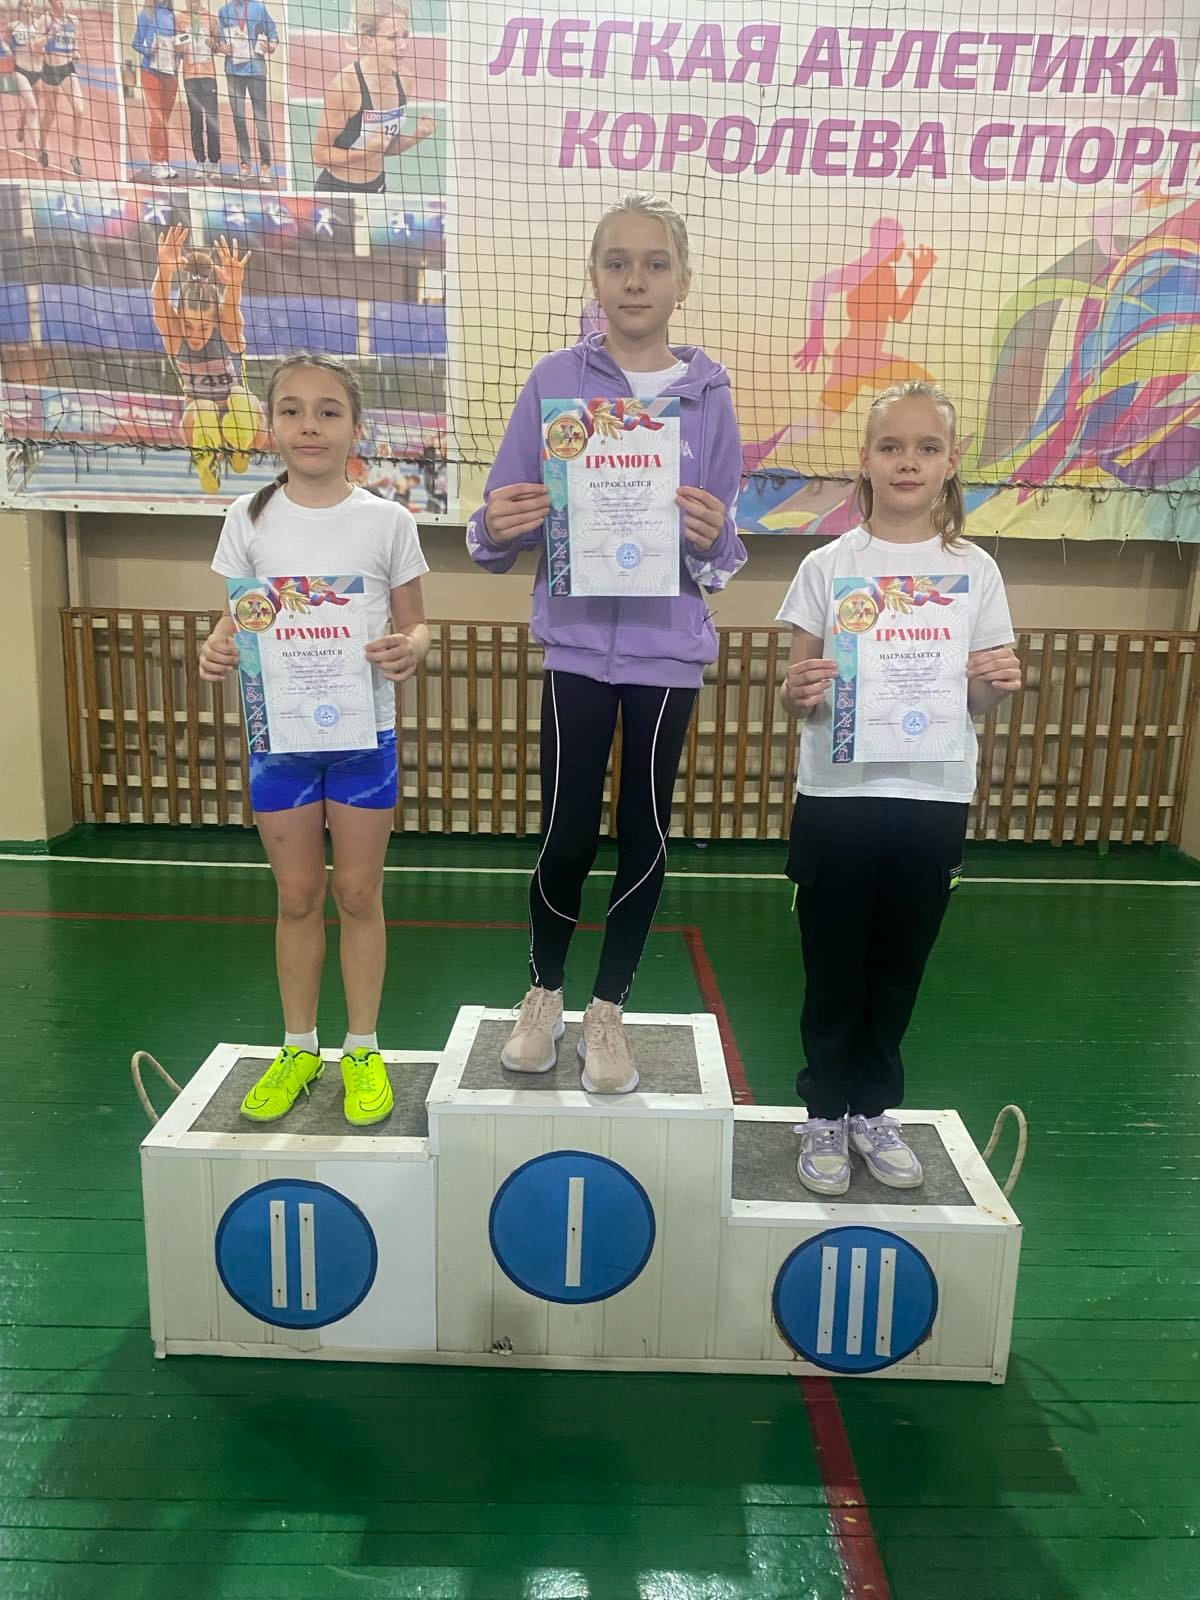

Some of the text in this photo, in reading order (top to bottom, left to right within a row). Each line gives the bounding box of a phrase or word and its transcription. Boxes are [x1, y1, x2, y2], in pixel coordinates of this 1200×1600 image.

[488, 17, 1179, 96] ЛЕГКАЯ АТЛЕТИКА
[558, 111, 1200, 189] КОРОЛЕВА СПОРТ
[586, 453, 662, 469] ГРАМОТА
[590, 480, 652, 489] НАГРАЖДАЕТСЯ
[275, 626, 351, 641] ГРАМОТА
[876, 627, 952, 641] ГРАМОТА
[282, 649, 343, 658] НАГРАЖДАЕТСЯ
[880, 651, 941, 660] НАГРАЖДАЕТСЯ
[269, 1200, 317, 1310] II
[817, 1246, 897, 1357] III
